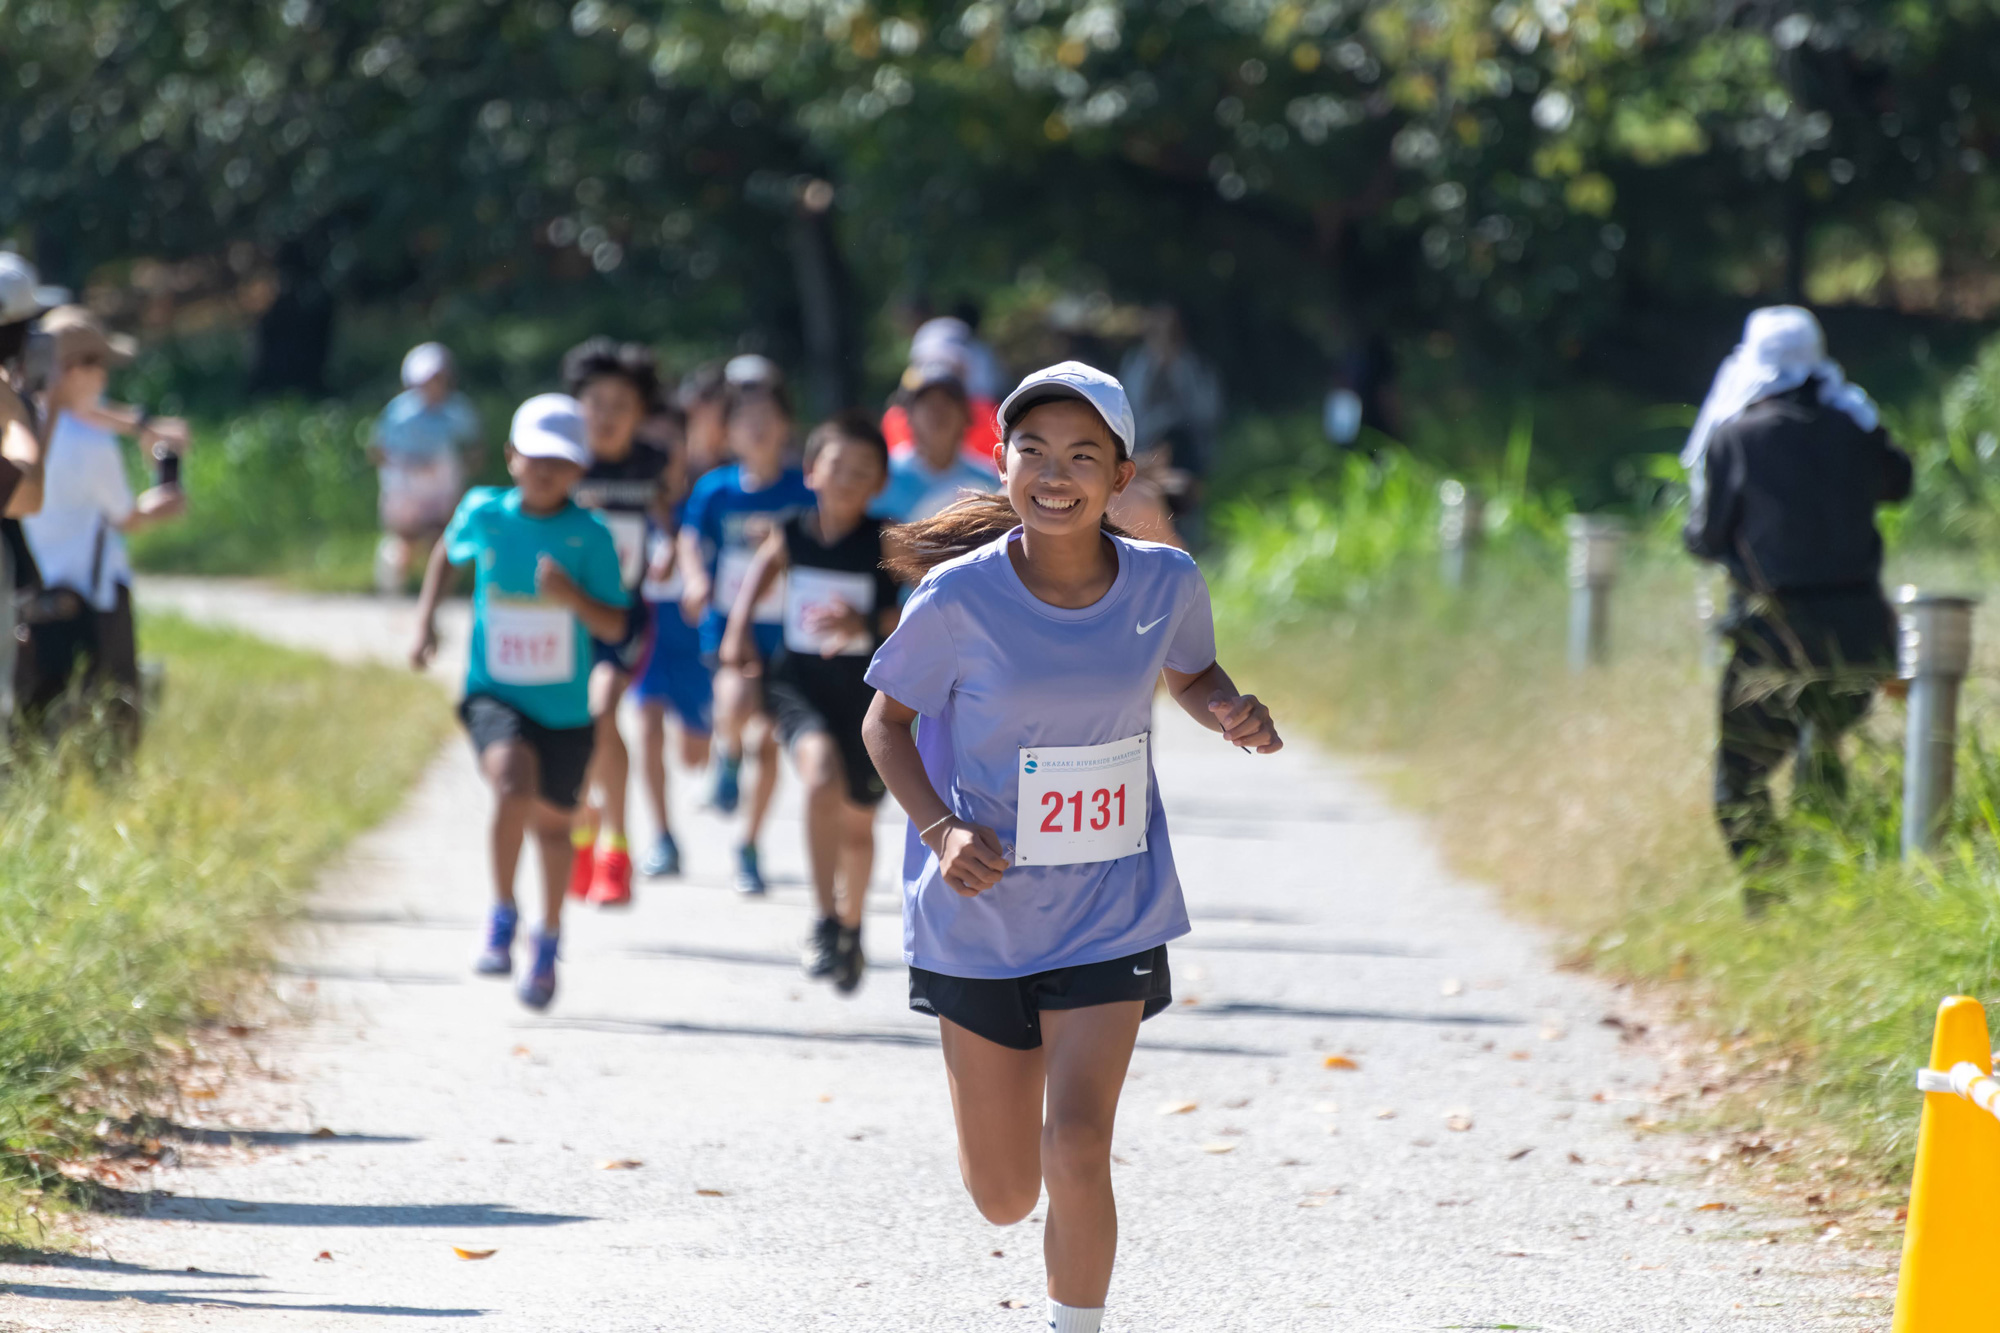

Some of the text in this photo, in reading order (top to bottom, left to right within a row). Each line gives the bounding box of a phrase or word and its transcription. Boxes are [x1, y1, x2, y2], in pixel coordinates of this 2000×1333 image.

[1076, 757, 1110, 767] RIVERSIDE
[1112, 749, 1141, 762] MARATHON
[1039, 783, 1126, 833] 2131
